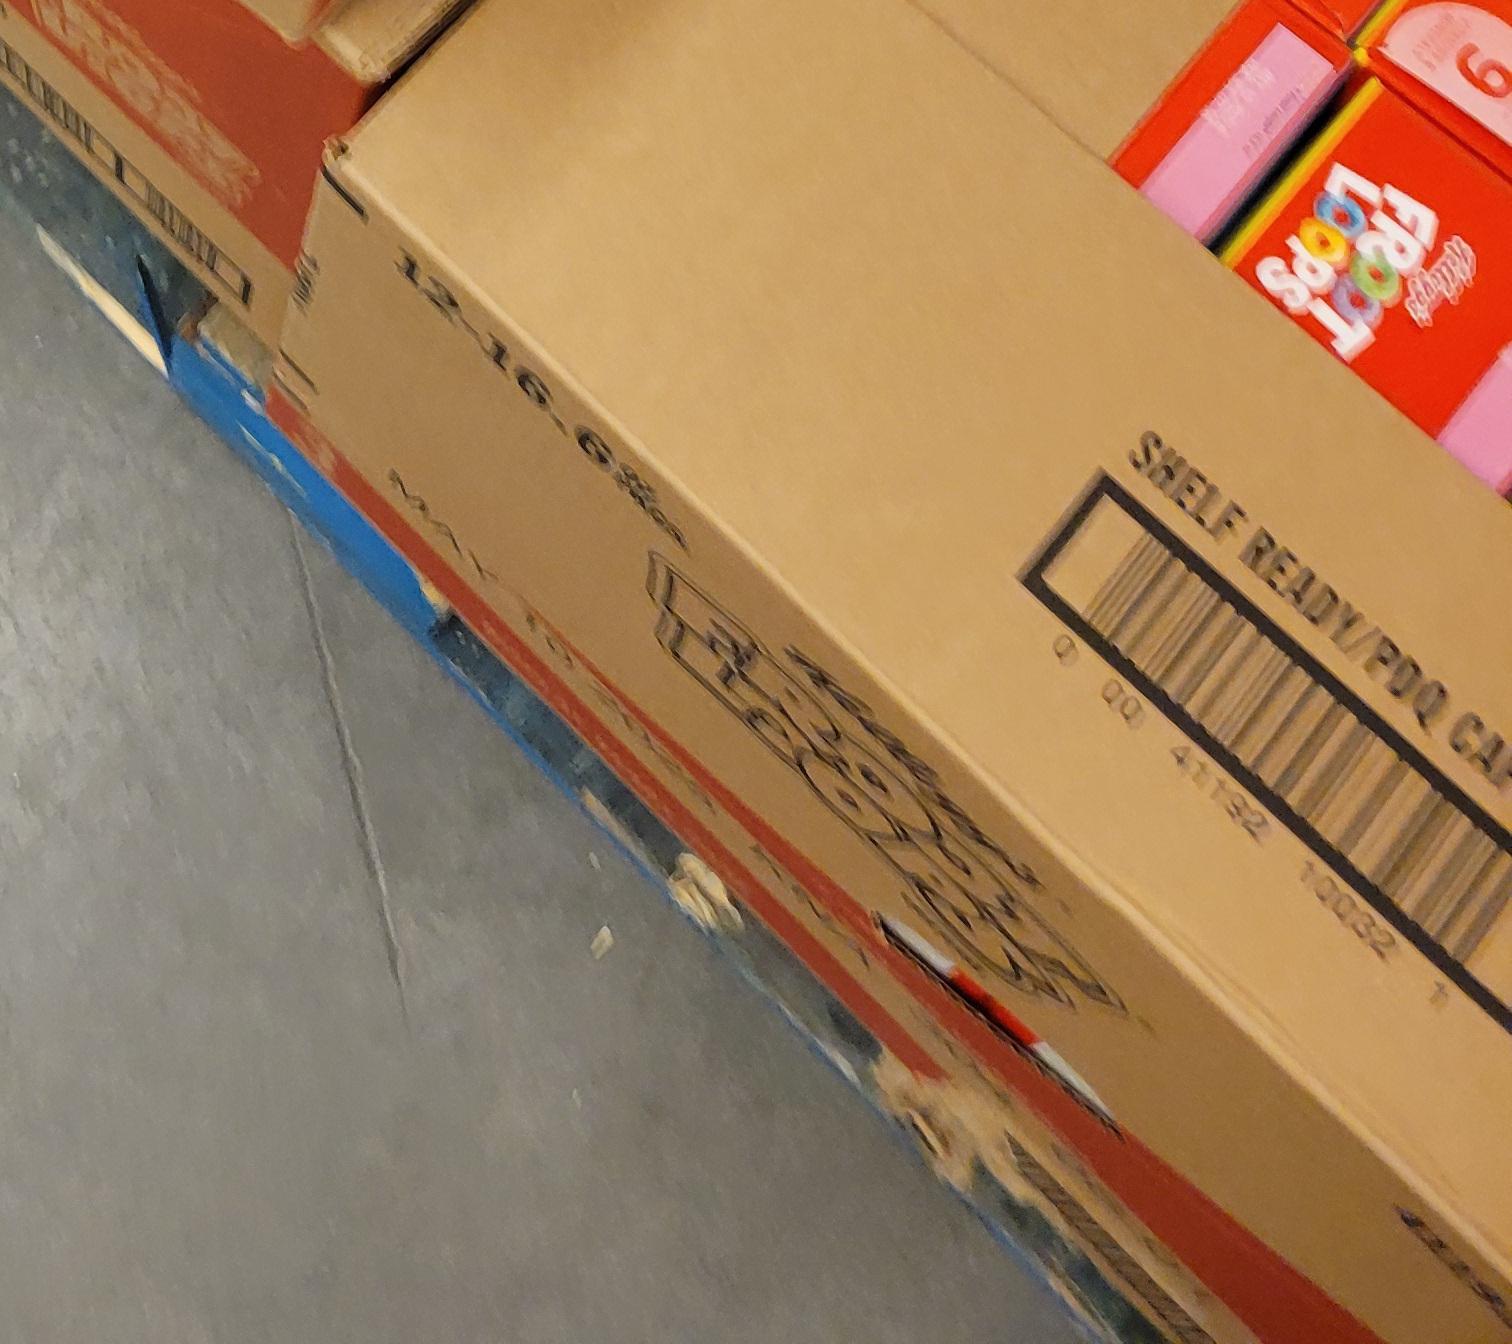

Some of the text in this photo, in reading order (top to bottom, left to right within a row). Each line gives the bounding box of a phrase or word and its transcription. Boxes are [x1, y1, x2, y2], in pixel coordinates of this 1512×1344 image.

[1255, 160, 1383, 317] LOOPS
[1306, 182, 1440, 365] FROOT
[391, 243, 618, 475] 12-16.6
[1128, 428, 1248, 544] SHELF
[1237, 524, 1452, 739] READY/PDQ
[647, 548, 1128, 1014] FROOT
[654, 612, 1076, 1010] LOOPS
[1099, 675, 1146, 733] 00
